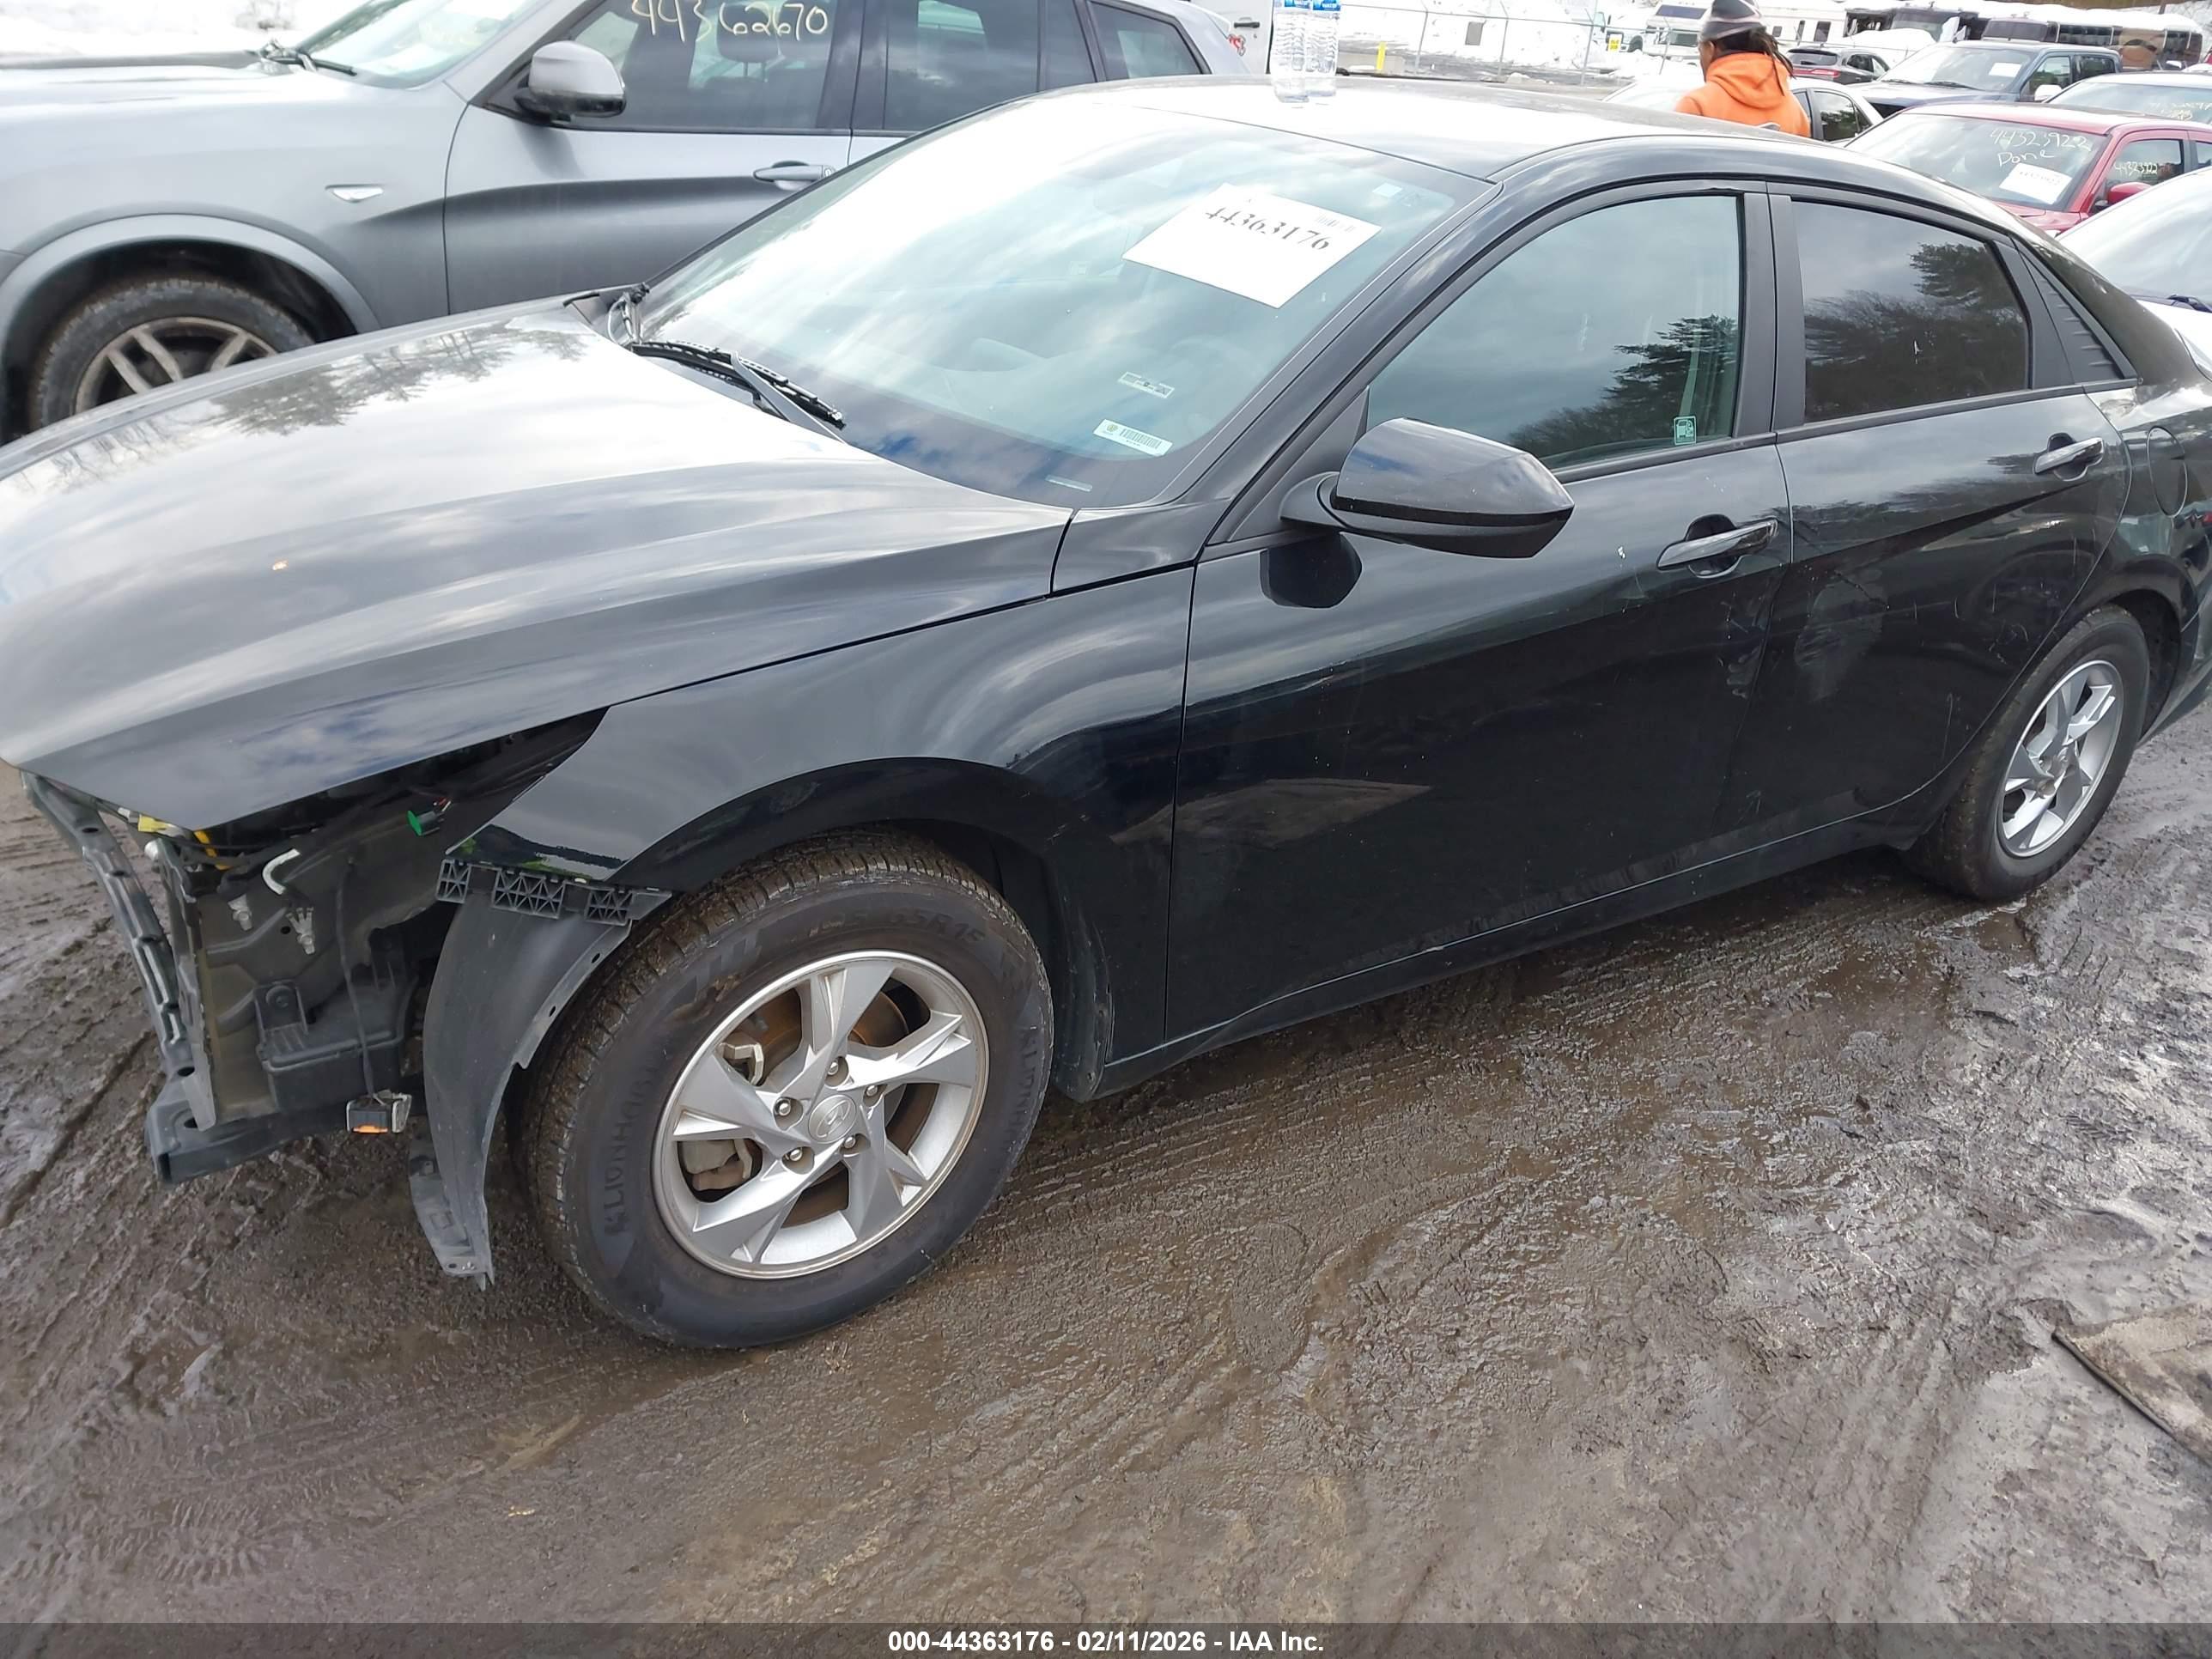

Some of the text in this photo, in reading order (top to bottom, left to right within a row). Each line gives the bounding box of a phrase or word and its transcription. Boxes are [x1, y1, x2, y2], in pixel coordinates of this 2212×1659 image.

[631, 0, 828, 42] 44362670
[1990, 129, 2092, 152] 44323922
[1997, 149, 2056, 167] Done
[1204, 206, 1331, 251] 44363176
